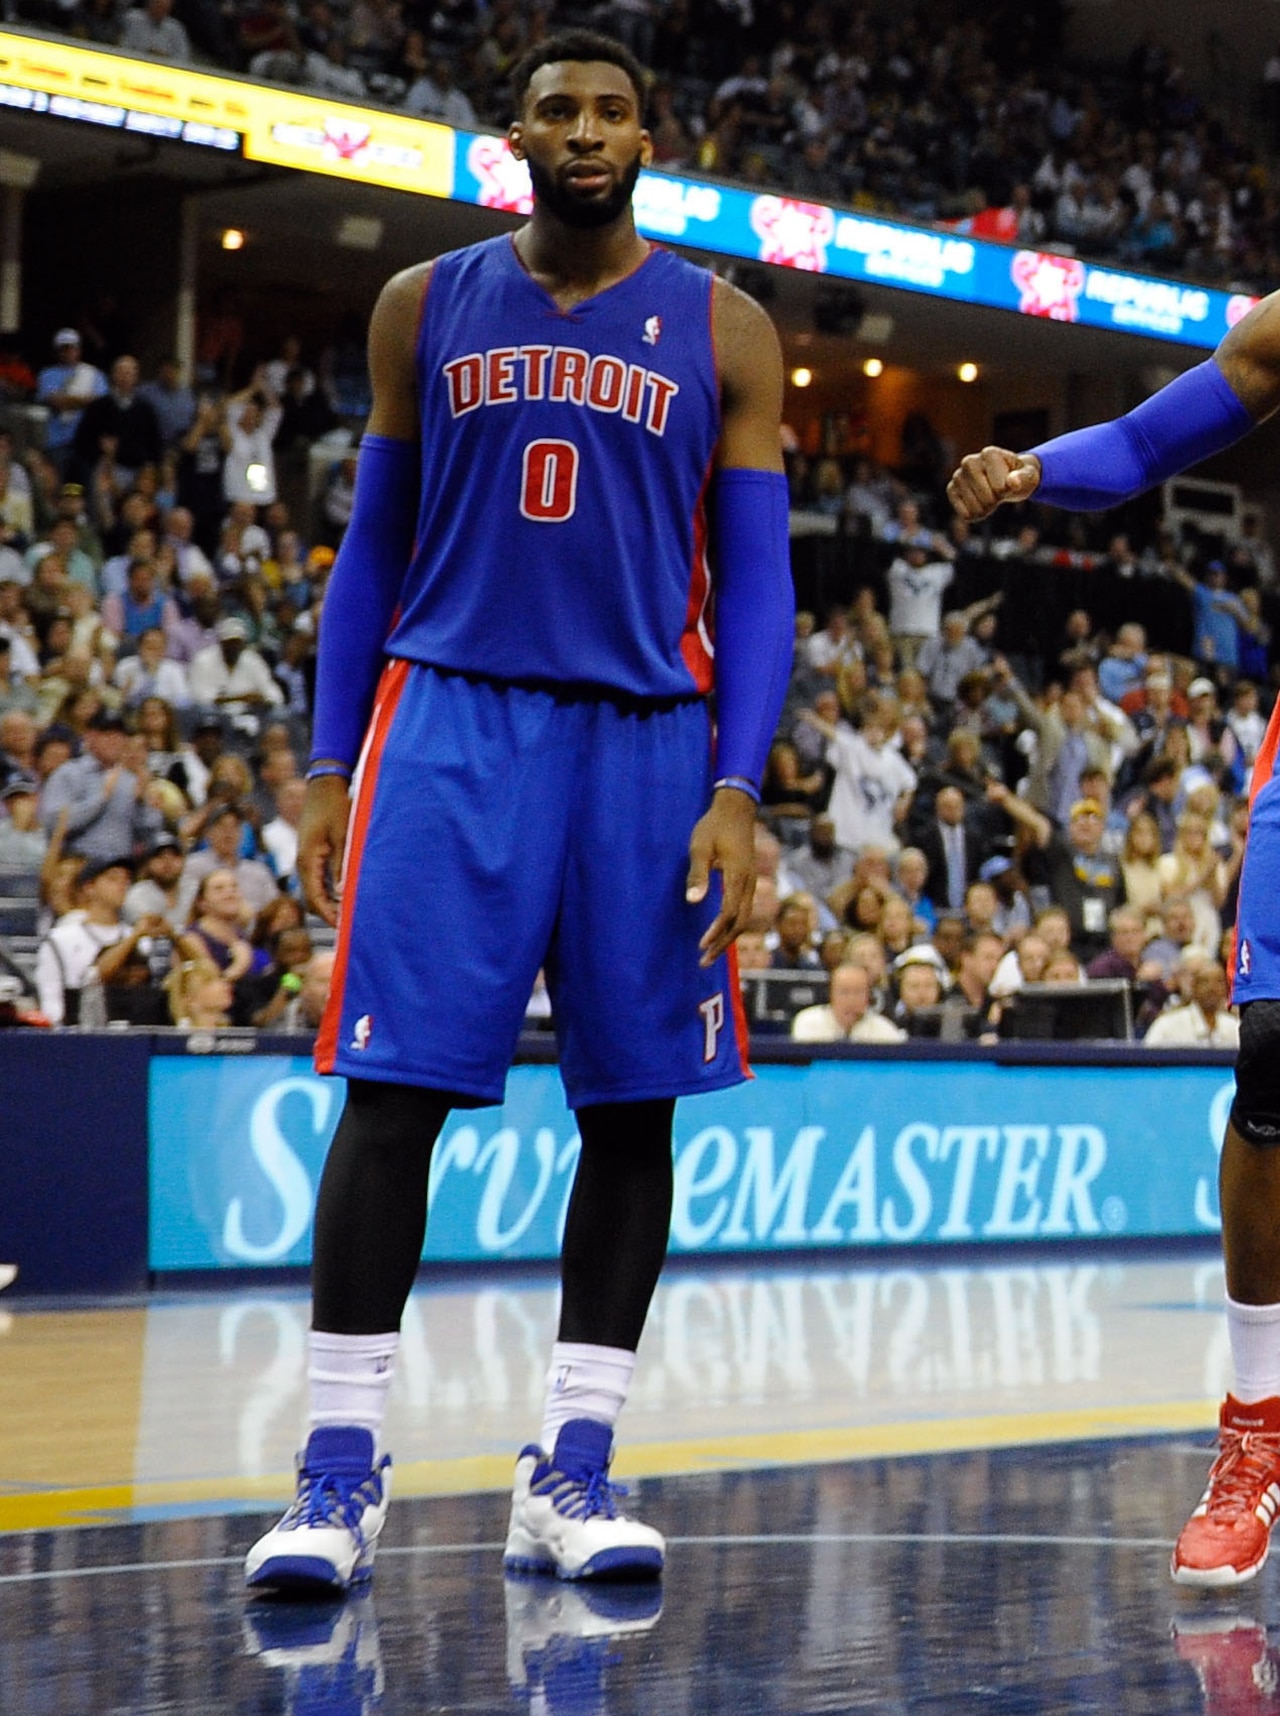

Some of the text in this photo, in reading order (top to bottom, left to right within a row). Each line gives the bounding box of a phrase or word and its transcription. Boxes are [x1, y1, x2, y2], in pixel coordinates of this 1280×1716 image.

[443, 344, 679, 437] DETROIT
[519, 438, 579, 523] 0
[697, 991, 725, 1064] P
